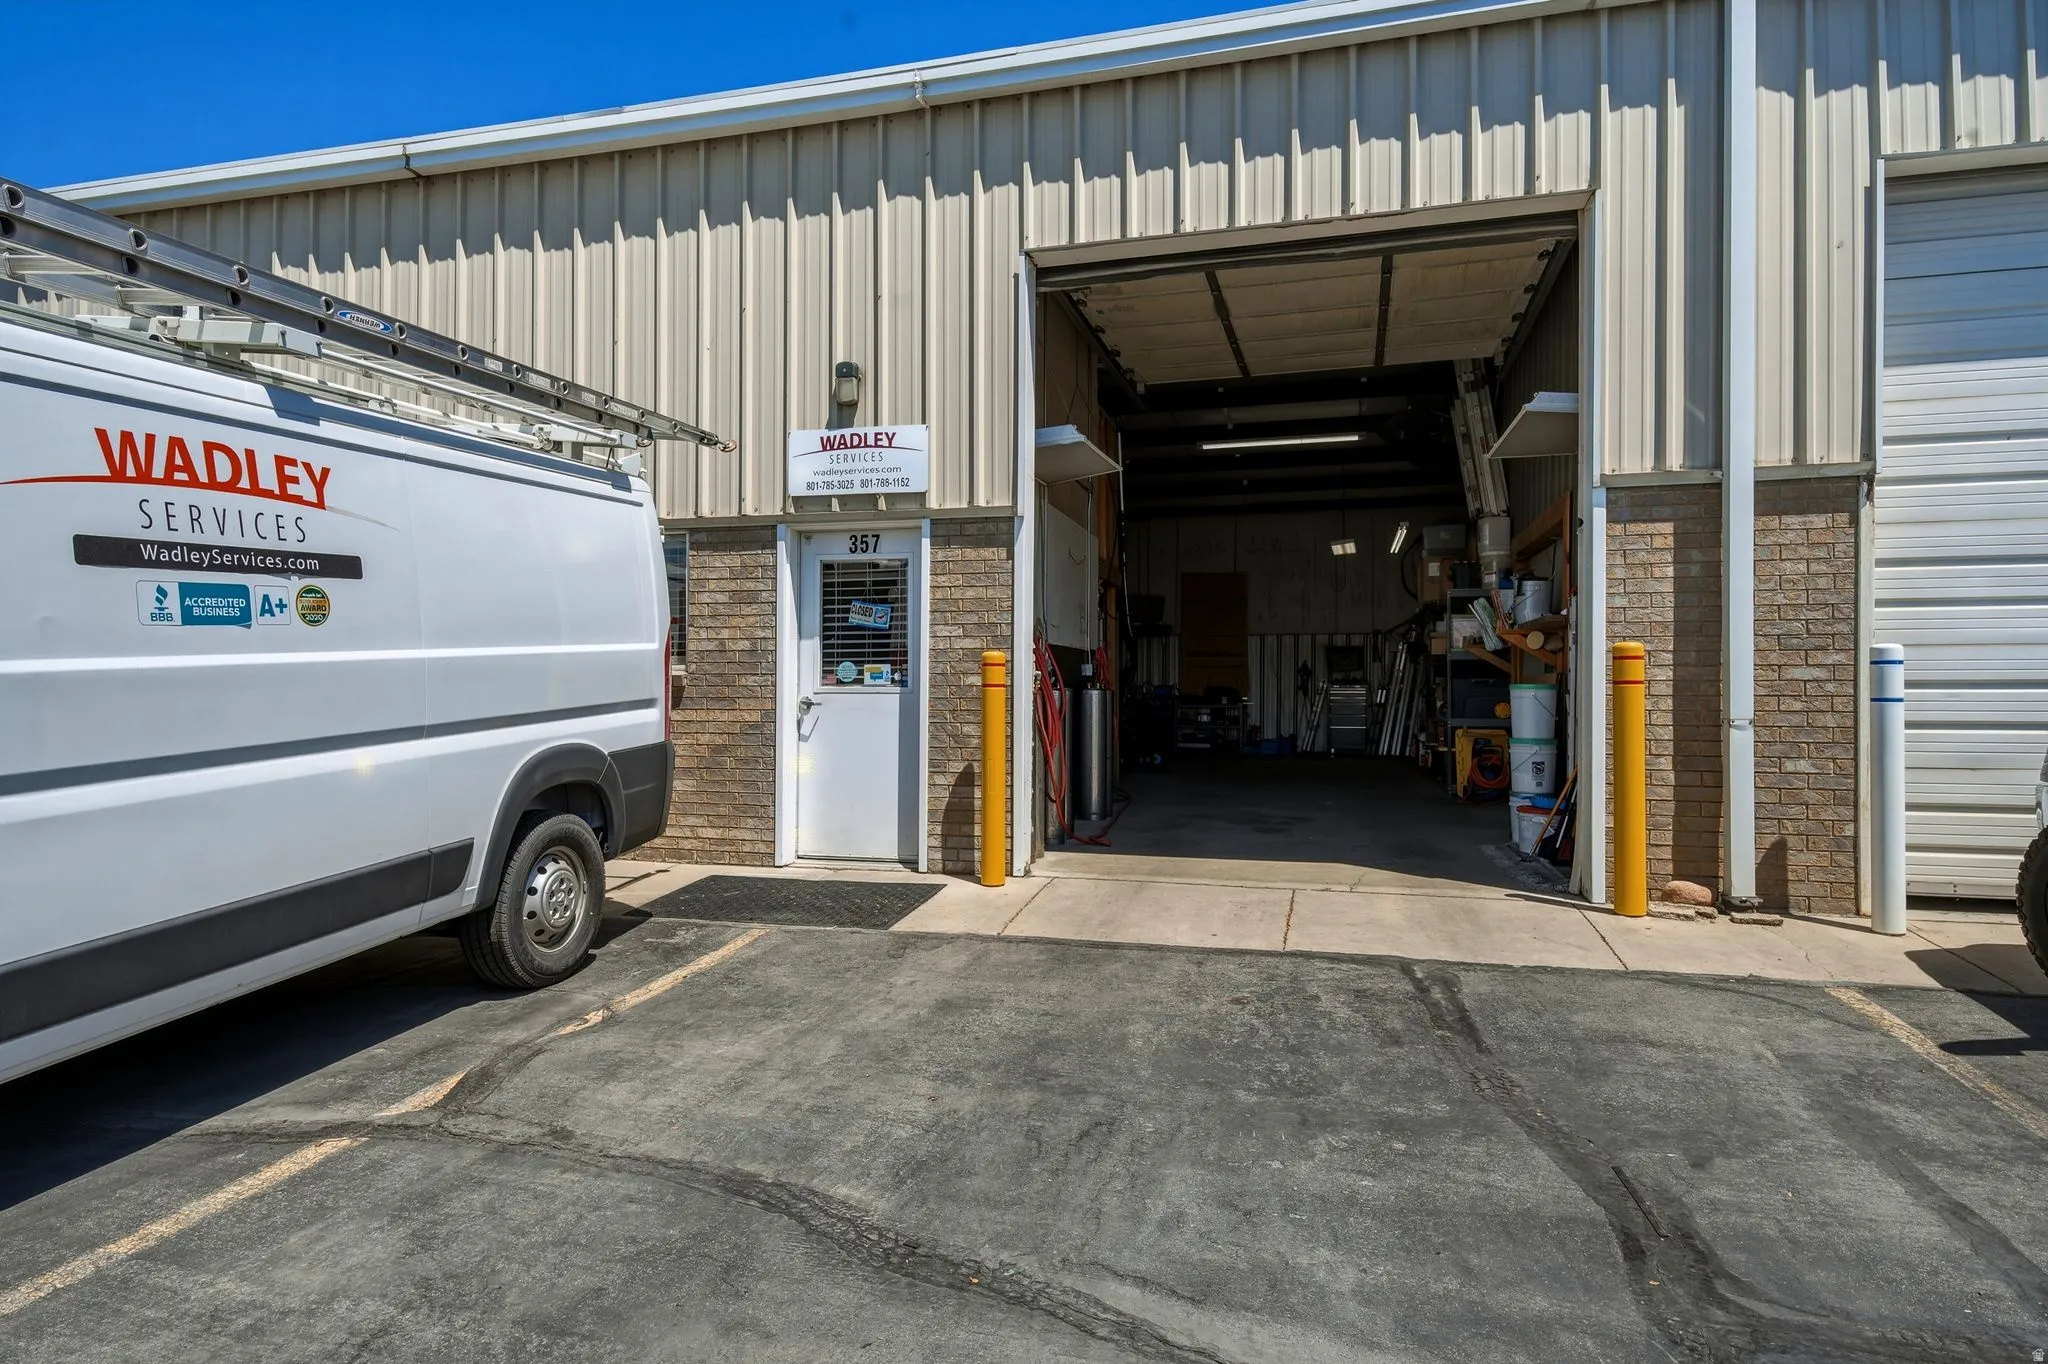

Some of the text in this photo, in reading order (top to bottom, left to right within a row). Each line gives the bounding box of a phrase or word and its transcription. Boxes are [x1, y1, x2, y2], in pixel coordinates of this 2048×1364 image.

[819, 432, 897, 451] WADLEY
[829, 451, 883, 464] SERVICES
[94, 427, 331, 511] WADLEY
[813, 465, 902, 477] wadleyservices.com
[806, 479, 855, 491] 801-785-3025
[138, 498, 306, 543] SERVICES
[848, 534, 881, 554] 357
[139, 543, 320, 571] WadleyServices.com
[184, 597, 246, 607] ACCREDITED
[259, 593, 288, 617] A+
[300, 604, 327, 612] AWARD
[150, 613, 174, 622] BBB
[192, 606, 241, 617] BUSINESS
[850, 603, 874, 618] CLOSED
